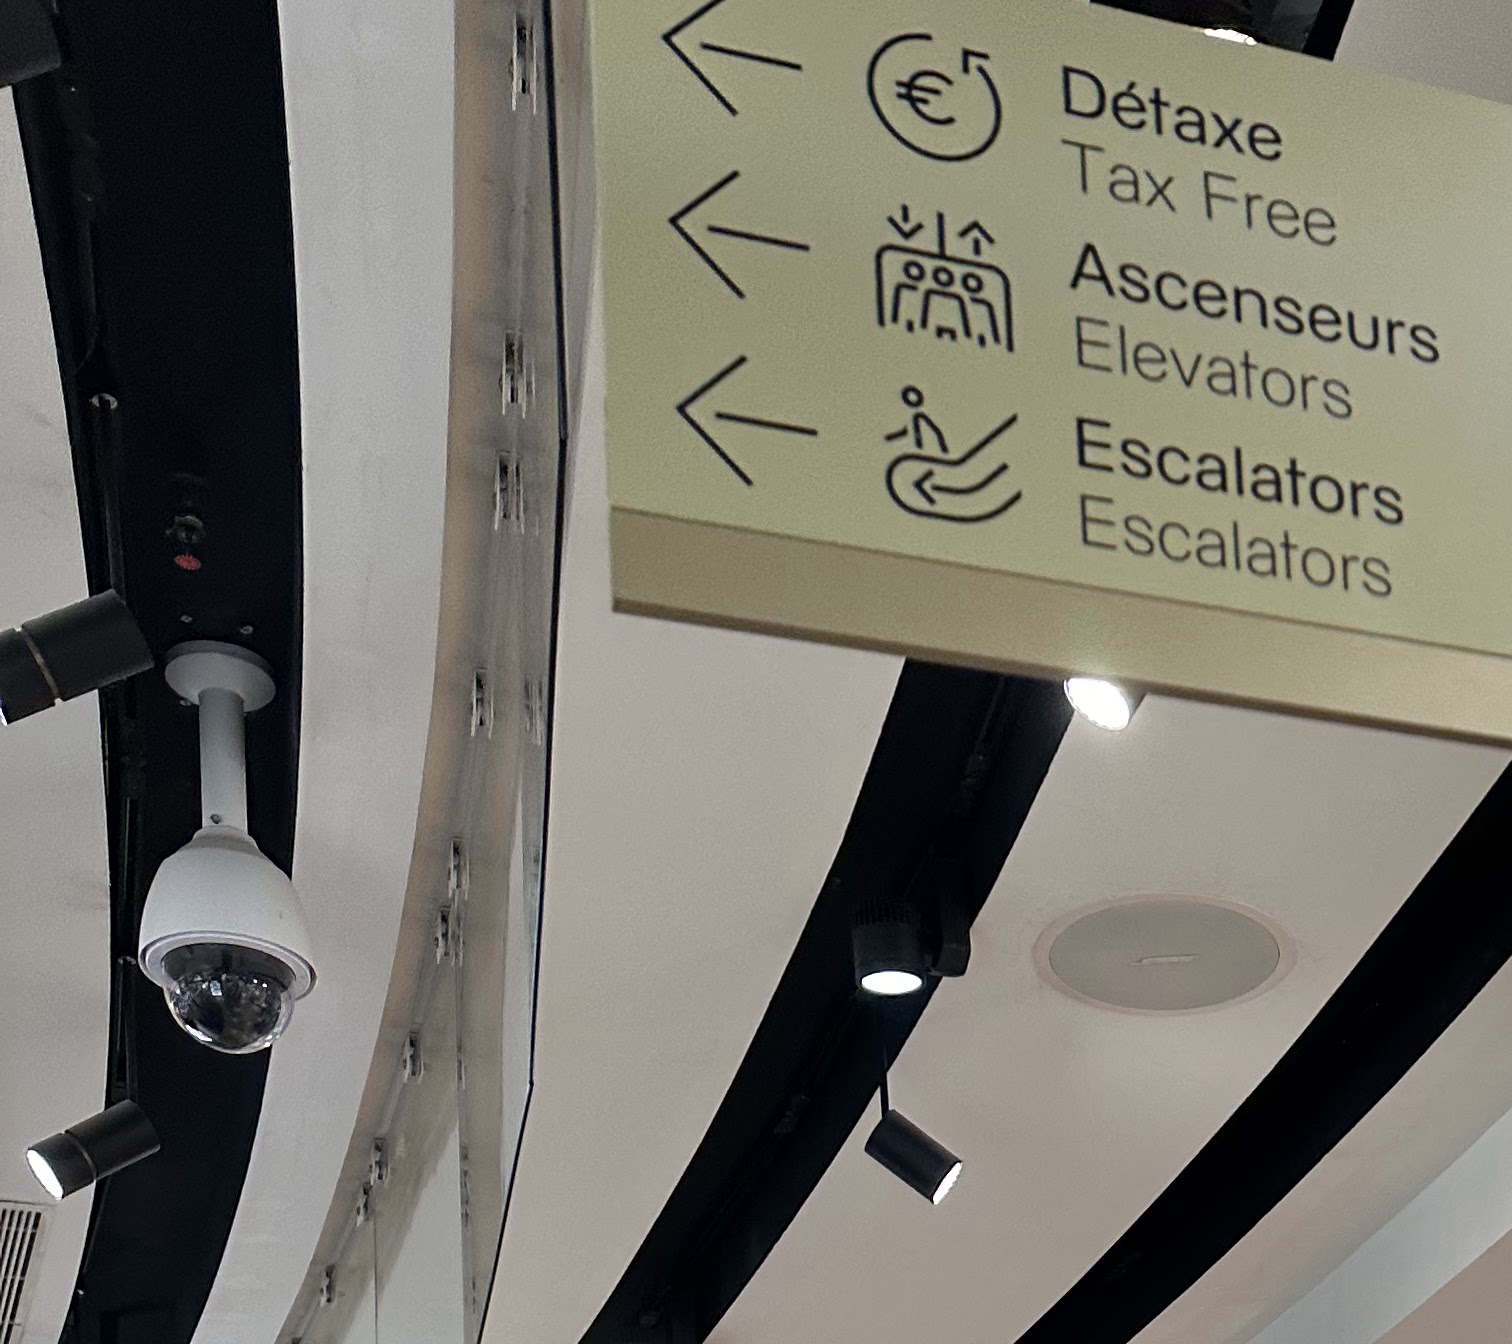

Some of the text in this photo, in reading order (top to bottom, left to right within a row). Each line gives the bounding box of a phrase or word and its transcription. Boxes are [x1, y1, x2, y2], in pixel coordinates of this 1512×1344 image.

[1062, 65, 1283, 162] Détaxe
[1062, 139, 1338, 248] Tax Free
[1070, 243, 1440, 365] Ascenseurs
[1076, 317, 1353, 421] Elevators
[1077, 418, 1403, 527] Escalators
[1080, 495, 1393, 599] Escalators
